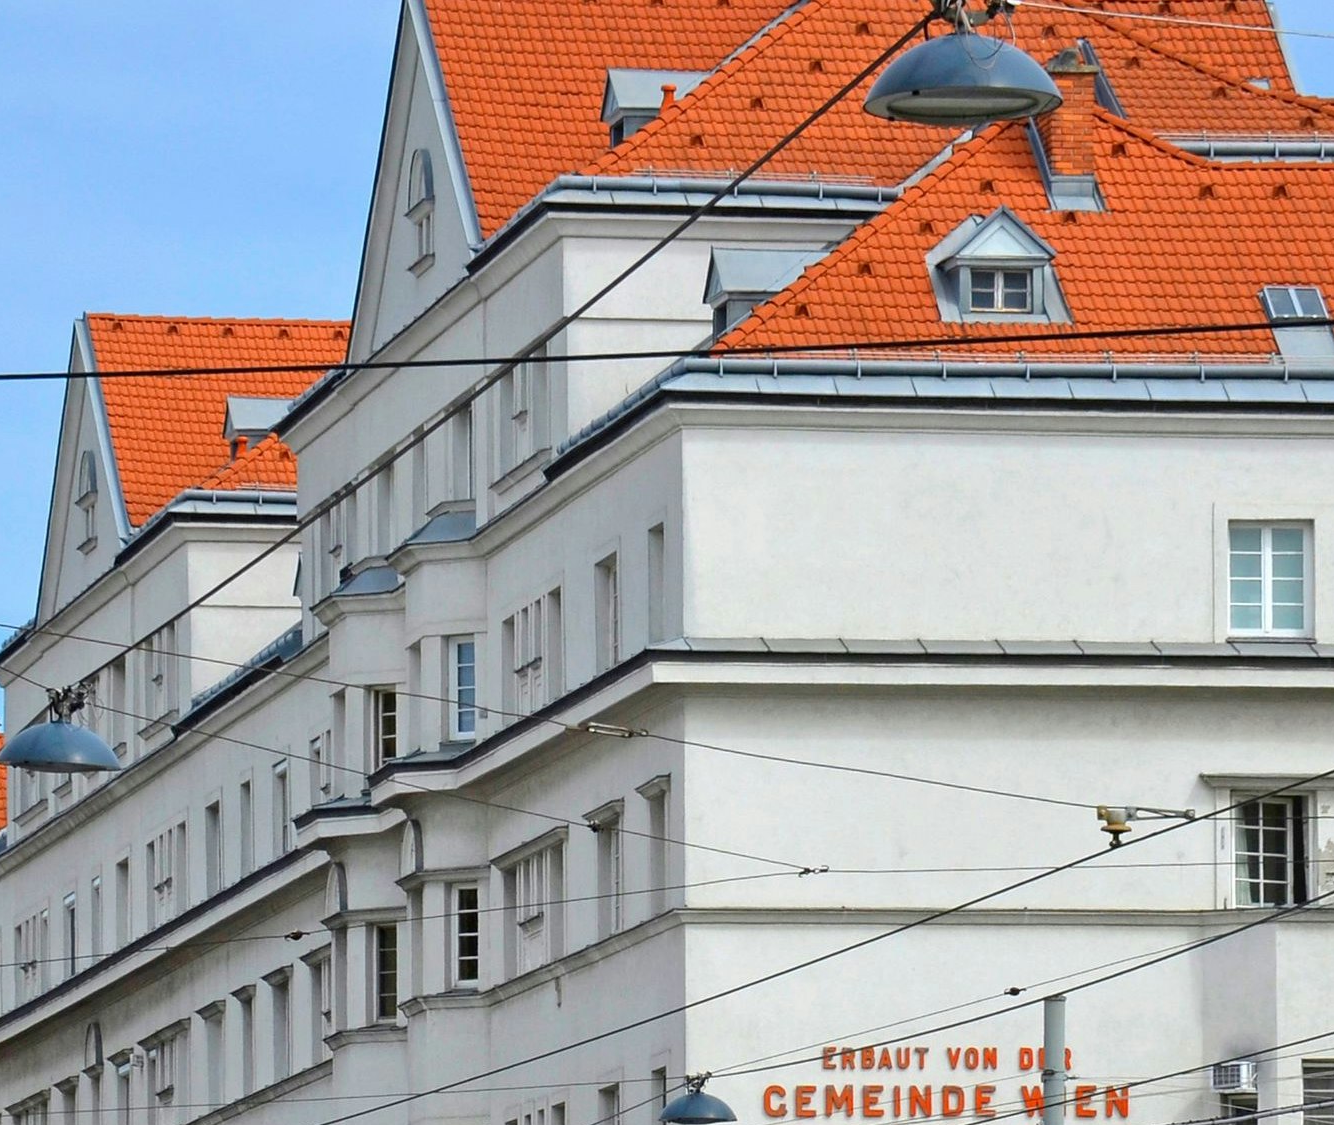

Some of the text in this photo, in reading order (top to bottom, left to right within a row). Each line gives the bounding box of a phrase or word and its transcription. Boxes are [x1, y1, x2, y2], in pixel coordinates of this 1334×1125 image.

[822, 1046, 929, 1070] ERBAUT
[946, 1047, 998, 1070] VON
[762, 1084, 1129, 1118] GEMEINDE WEN
